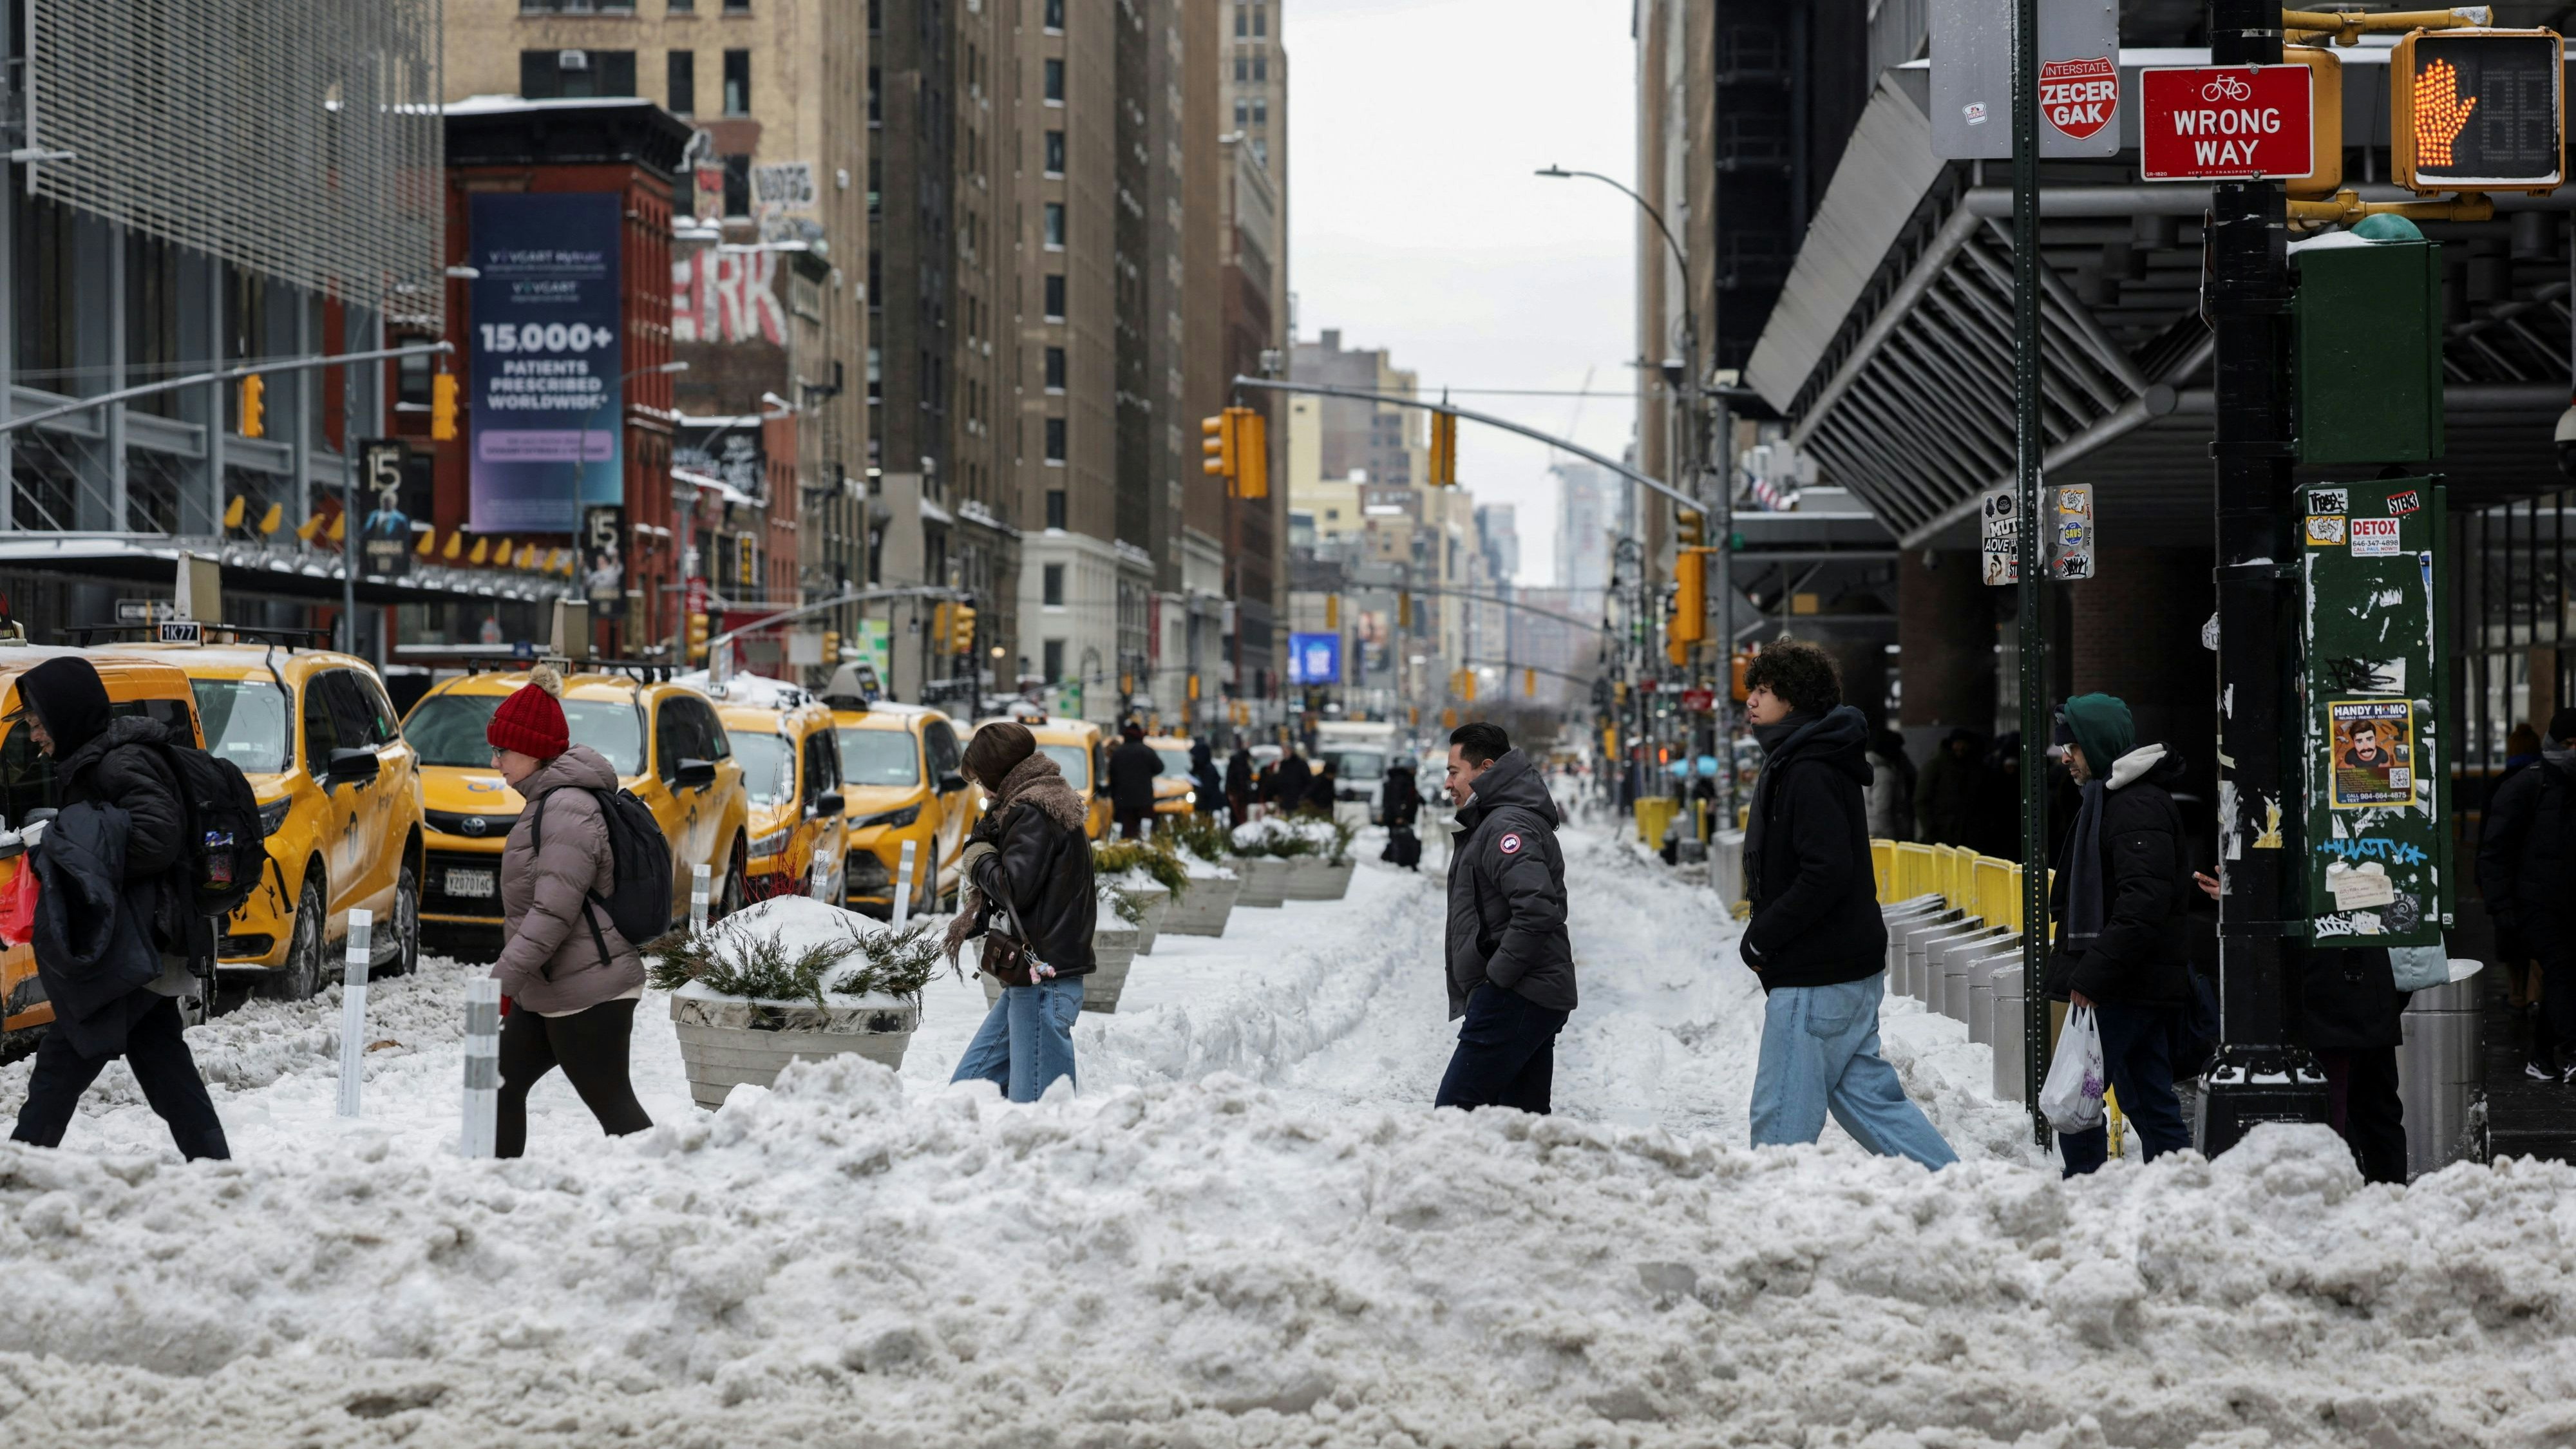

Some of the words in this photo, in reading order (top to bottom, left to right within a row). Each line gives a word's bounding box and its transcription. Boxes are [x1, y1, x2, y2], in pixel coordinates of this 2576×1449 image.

[2046, 62, 2108, 76] INTERSTATE
[2041, 80, 2116, 105] ZECER
[2053, 103, 2105, 126] GAK
[2174, 108, 2280, 135] WRONG
[2195, 140, 2259, 166] WAY
[480, 323, 613, 354] 15,000+
[504, 359, 589, 375] PATIENTS
[490, 377, 603, 392] PRESCRIBED
[368, 453, 402, 492] 15
[2389, 493, 2418, 513] STEN3
[2065, 528, 2082, 539] SAVS
[2353, 520, 2396, 535] DETOX
[1984, 538, 2009, 552] AOVE
[164, 625, 194, 640] 1K77
[2334, 706, 2371, 716] HANDY
[2374, 704, 2407, 715] HOMO
